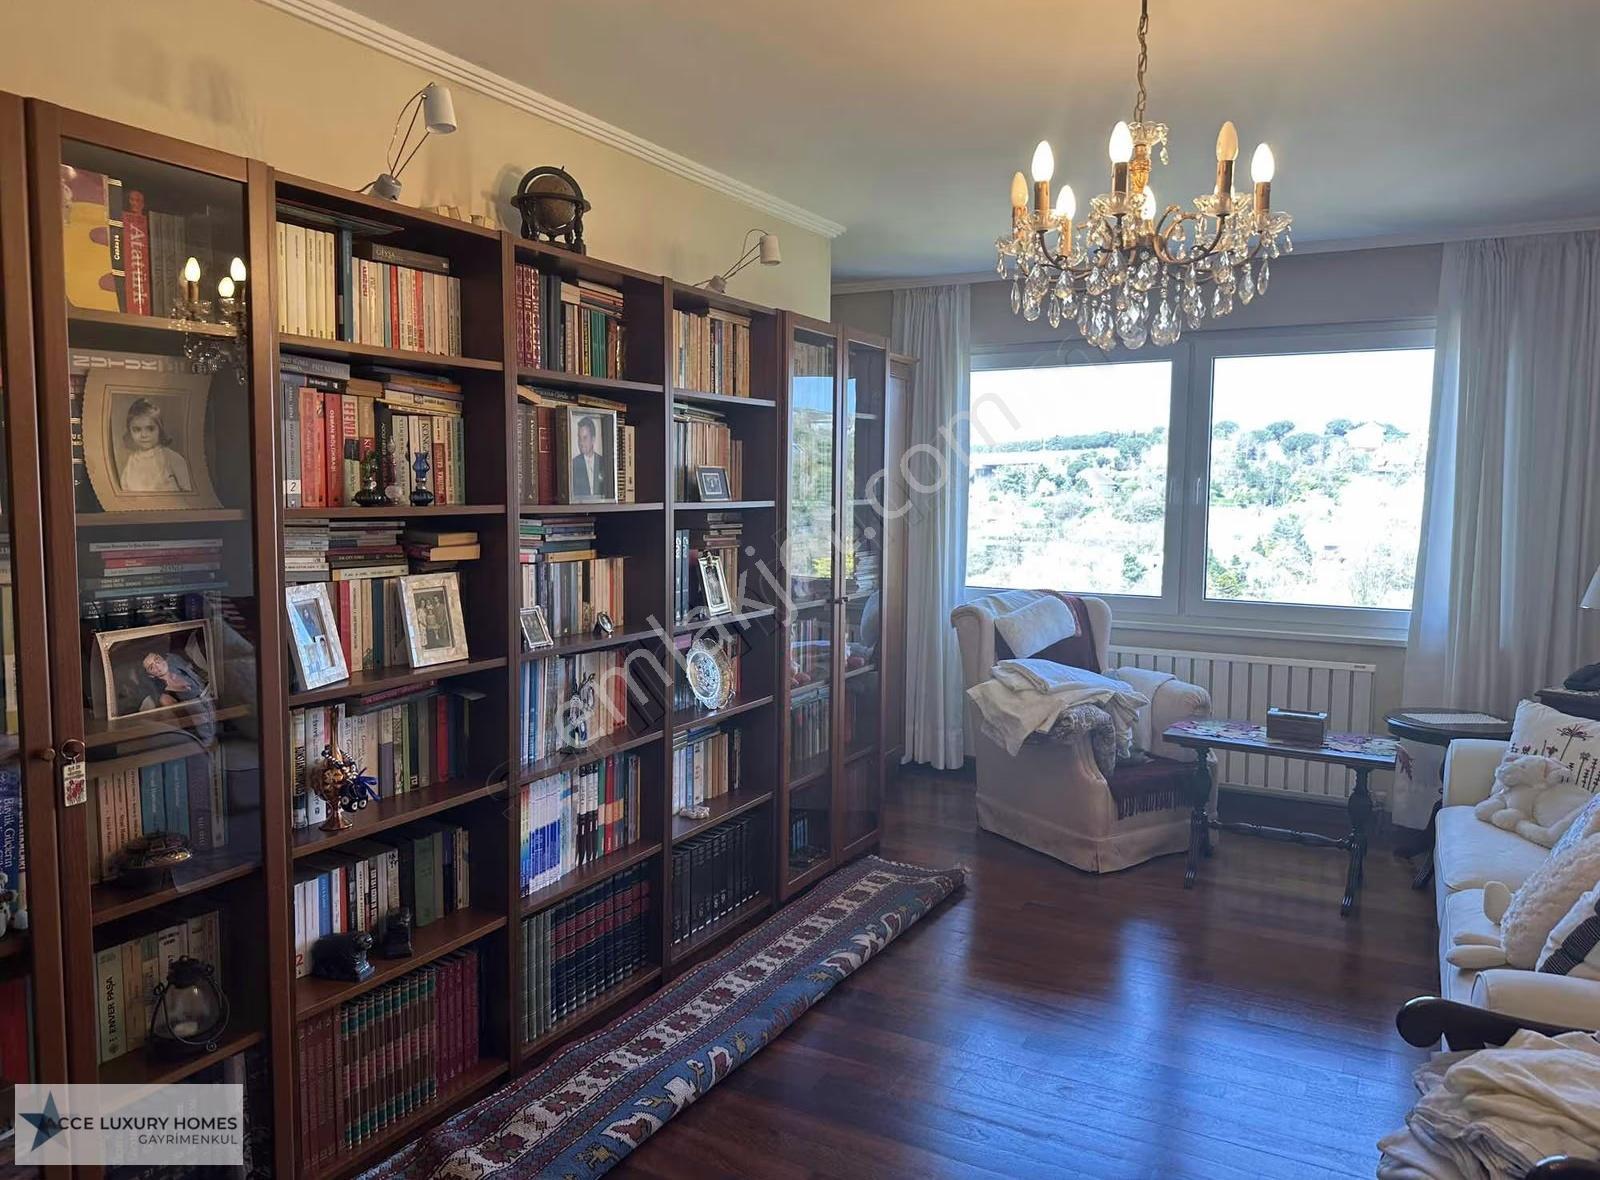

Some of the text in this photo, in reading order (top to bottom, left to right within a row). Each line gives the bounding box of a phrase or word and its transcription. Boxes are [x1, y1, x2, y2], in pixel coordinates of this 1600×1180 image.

[130, 223, 147, 305] Atatürk
[72, 354, 158, 371] NUTUK
[105, 976, 116, 1001] PAŞA
[106, 1002, 117, 1034] ENVER
